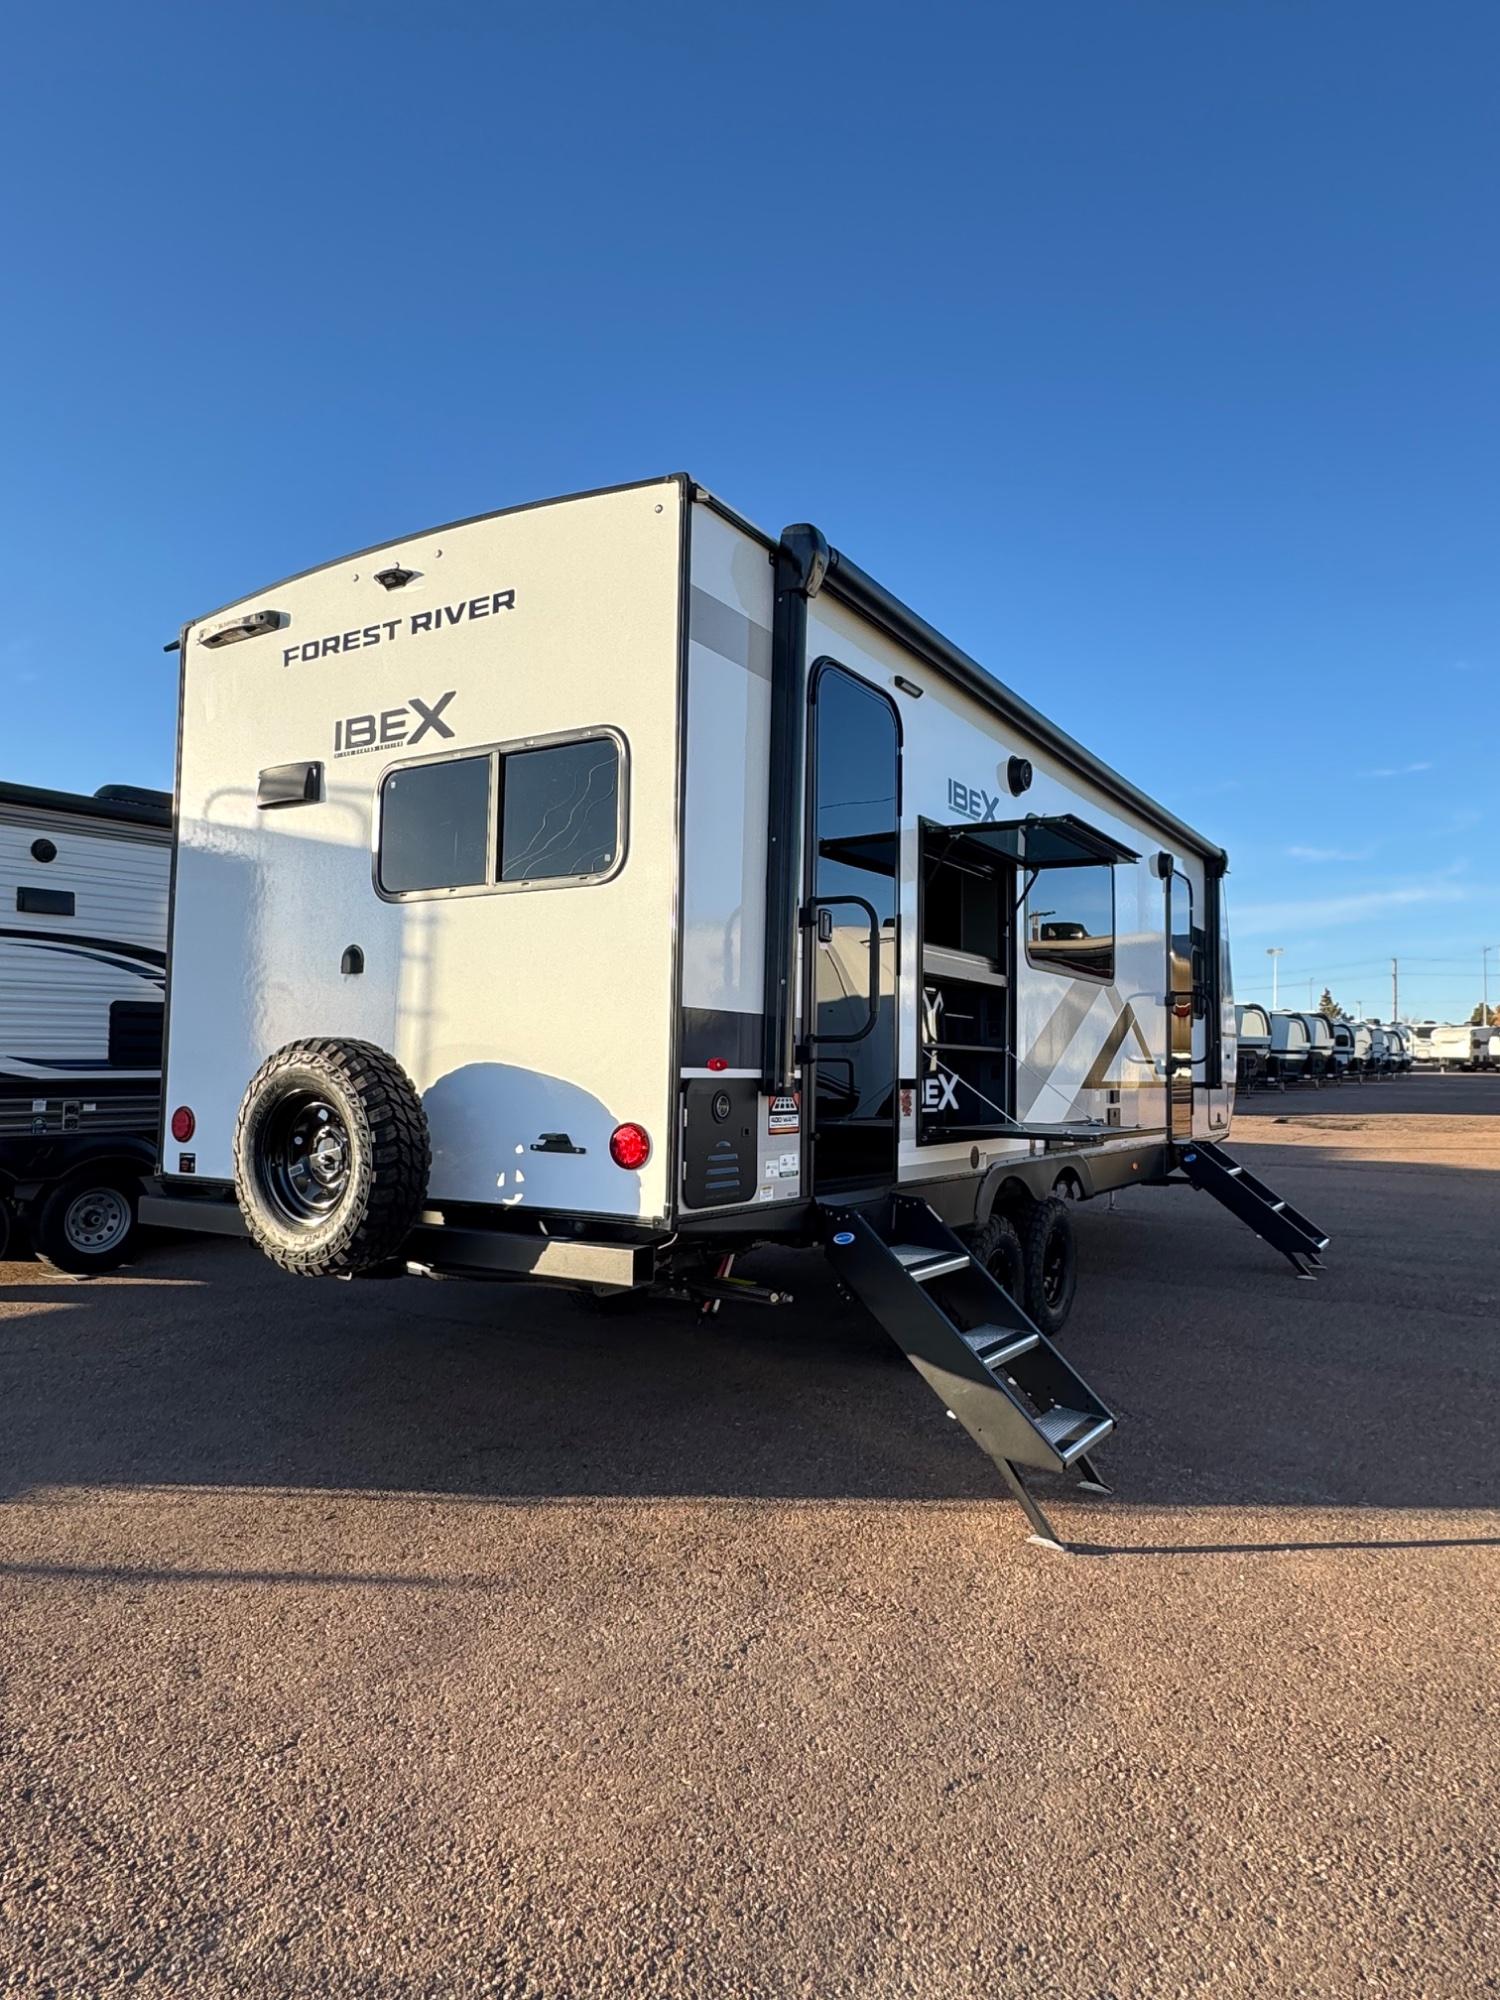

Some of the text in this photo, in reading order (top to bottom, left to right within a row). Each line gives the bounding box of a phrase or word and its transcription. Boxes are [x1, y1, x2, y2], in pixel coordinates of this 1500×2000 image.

[283, 589, 516, 668] FOREST RIVER
[334, 690, 457, 752] IBEX
[948, 777, 1000, 822] IBEX
[921, 1073, 959, 1110] EX
